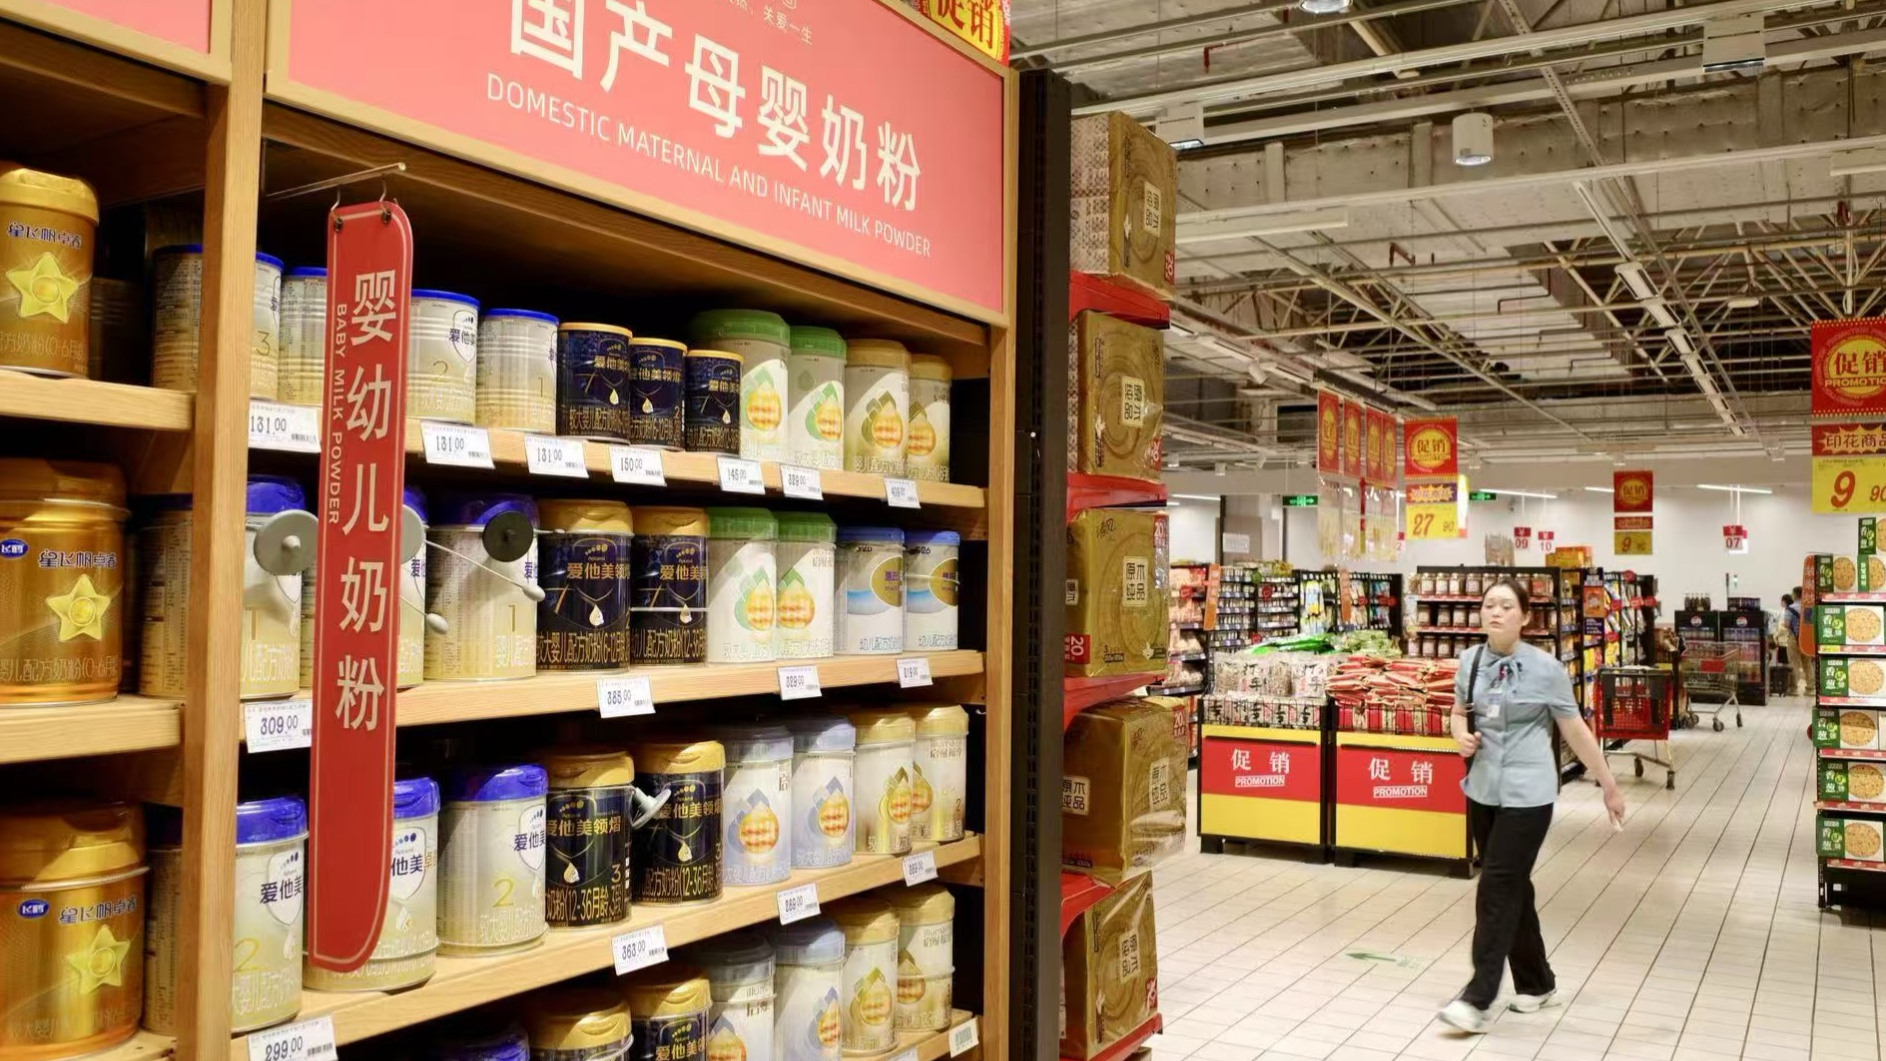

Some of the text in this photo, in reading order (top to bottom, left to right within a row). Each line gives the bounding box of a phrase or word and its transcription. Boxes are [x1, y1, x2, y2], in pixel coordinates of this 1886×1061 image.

[510, 0, 921, 211] 国产母婴奶粉
[487, 72, 932, 258] DOMESTIC MATERNAL AND INFANT MILK POWDER
[1834, 350, 1886, 376] 促销
[250, 415, 287, 435] 131.00
[328, 303, 348, 525] BABY MILK POWDER
[436, 435, 465, 453] 131.00
[537, 447, 562, 463] 131.00
[620, 457, 643, 472] 150.00
[1830, 470, 1856, 508] 9
[335, 270, 396, 732] 婴幼儿奶粉
[1412, 513, 1434, 536] 27
[1515, 538, 1528, 548] 09
[1726, 537, 1740, 548] 07
[1071, 636, 1084, 657] 20
[260, 714, 298, 736] 309.00
[1231, 748, 1290, 774] 促销
[1368, 757, 1433, 784] 促销
[1235, 776, 1285, 787] PROMOTION
[1373, 786, 1427, 797] PROMOTION
[611, 863, 621, 883] 3
[492, 878, 514, 908] 2
[265, 1035, 304, 1061] 299.00
